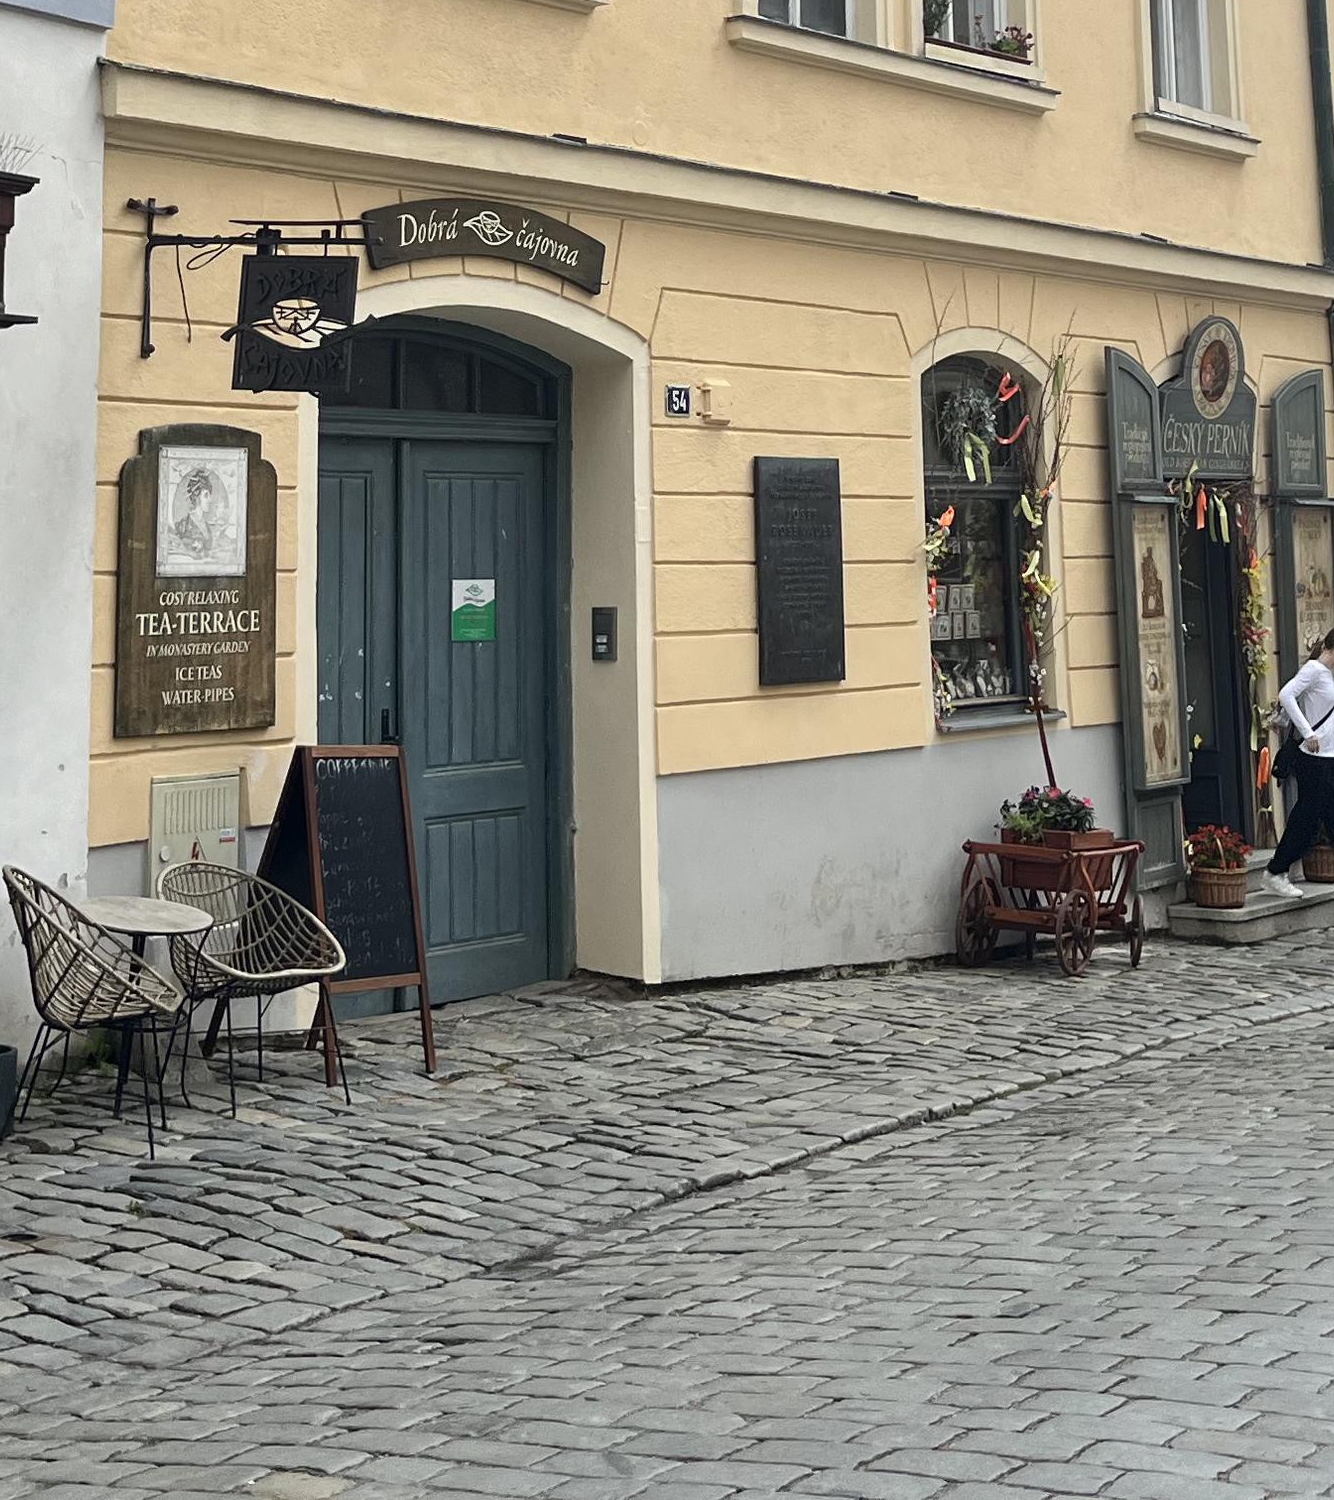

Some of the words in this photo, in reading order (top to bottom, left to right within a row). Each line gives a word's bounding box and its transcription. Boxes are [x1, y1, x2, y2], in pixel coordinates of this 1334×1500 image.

[397, 211, 460, 248] Dobrá
[515, 218, 579, 268] čajovna
[672, 389, 687, 412] 54
[1163, 413, 1205, 455] ČESKÝ
[1206, 420, 1251, 458] PERNÍK
[187, 589, 240, 606] RELAXING
[135, 609, 260, 636] TEA-TERRACE
[158, 642, 214, 658] MONASTERY
[213, 640, 251, 655] GARDEN
[174, 666, 195, 682] ICE
[195, 664, 223, 680] TEAS
[161, 687, 235, 706] WATER-PIPES
